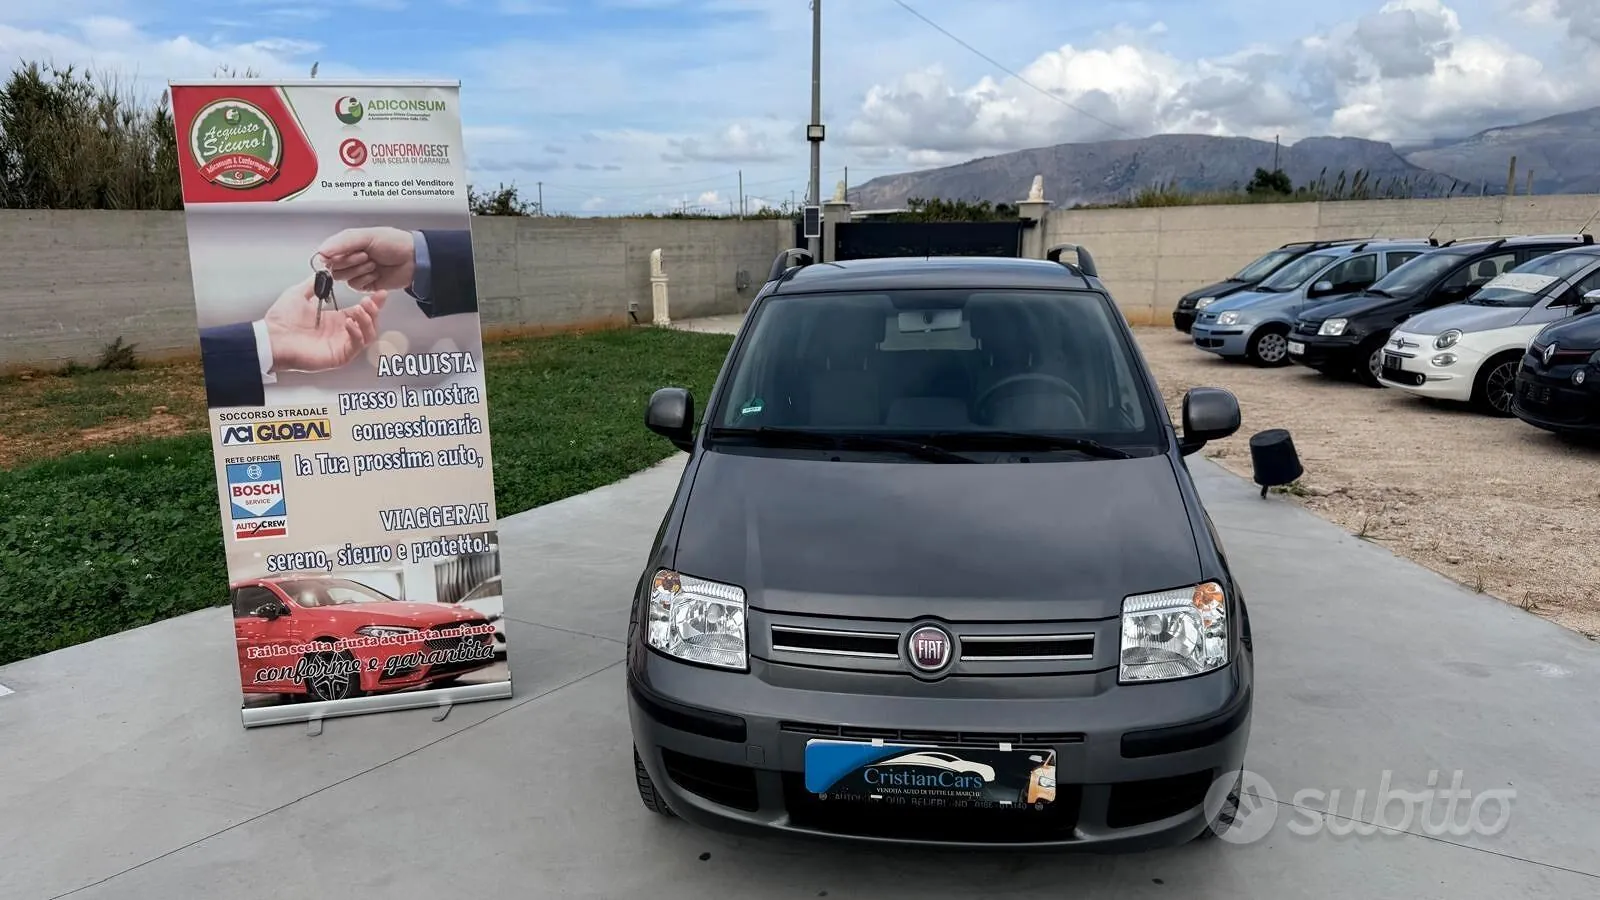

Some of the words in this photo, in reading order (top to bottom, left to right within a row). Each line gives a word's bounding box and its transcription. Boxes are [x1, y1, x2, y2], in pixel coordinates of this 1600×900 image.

[368, 100, 446, 111] ADICONSUM
[204, 122, 260, 140] Acquisto
[203, 129, 266, 156] Sicuro!
[371, 144, 449, 157] CONFORMGEST
[378, 352, 476, 377] ACQUISTA
[339, 391, 397, 415] presso
[401, 385, 421, 408] la
[423, 383, 479, 405] nostra
[220, 410, 275, 420] SOCCORSO
[277, 408, 328, 418] STRADALE
[224, 426, 254, 444] ACI
[256, 422, 330, 442] GLOBAL
[352, 413, 482, 442] concessionaria
[246, 454, 280, 463] OFFICINE
[295, 454, 313, 476] la
[315, 452, 350, 474] Tua
[354, 448, 434, 476] prossima
[438, 444, 484, 468] auto,
[232, 484, 280, 497] BOSCH
[236, 521, 258, 530] AUTO
[261, 520, 285, 528] CREW
[380, 503, 490, 531] VIAGGERAI
[267, 550, 333, 572] sereno,
[337, 544, 392, 566] sicuro
[397, 544, 408, 560] e
[412, 533, 490, 564] protetto!
[247, 646, 272, 659] Fai
[274, 644, 288, 658] la
[290, 640, 332, 656] scelta
[334, 635, 378, 653] giusta
[380, 630, 440, 648] acquista
[442, 624, 496, 639] un'auto
[918, 640, 943, 660] FIAT
[254, 656, 362, 684] conforme
[366, 658, 378, 671] e
[382, 638, 496, 676] garantita
[864, 768, 982, 788] CristianCars
